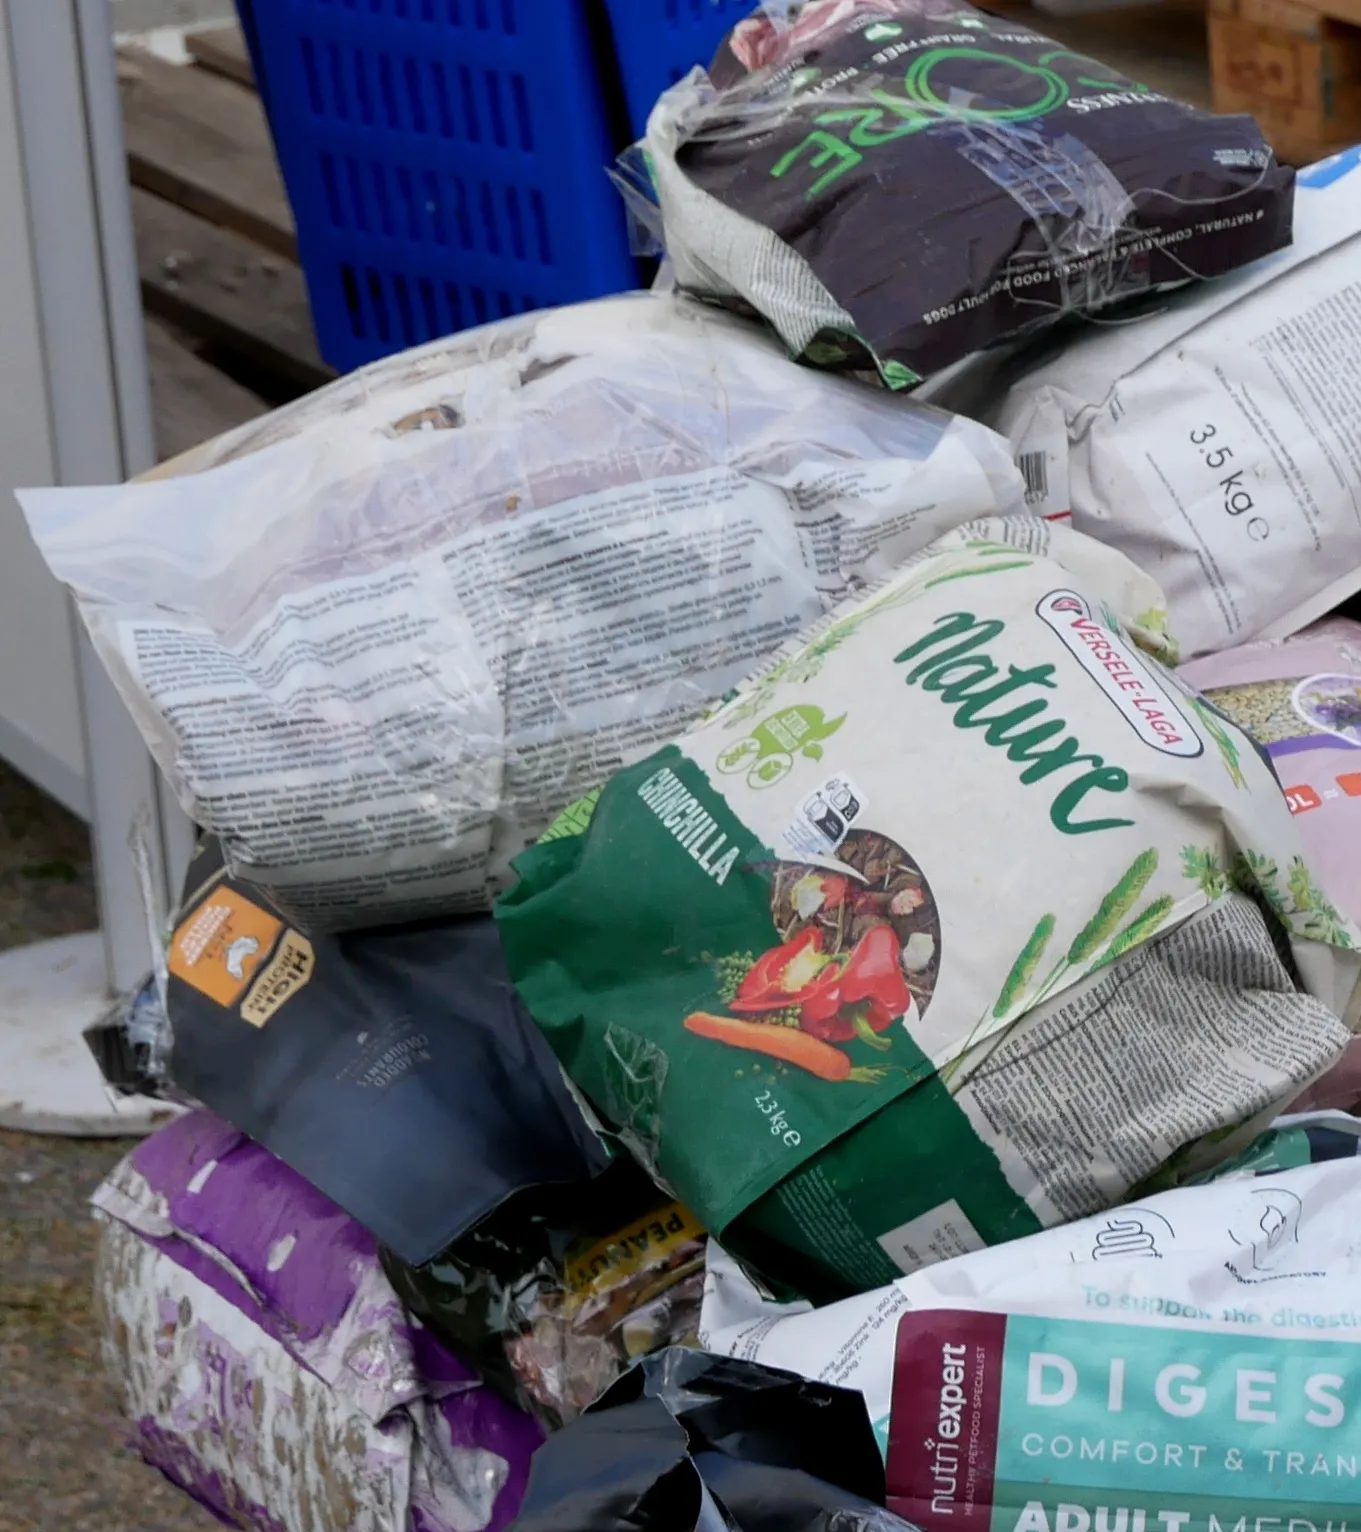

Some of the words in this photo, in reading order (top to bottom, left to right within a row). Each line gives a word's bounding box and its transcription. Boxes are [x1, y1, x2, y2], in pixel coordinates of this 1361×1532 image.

[1013, 267, 1050, 287] FOOD
[922, 303, 957, 325] DOGS
[1189, 421, 1232, 470] 3.5
[1218, 469, 1254, 519] kg
[893, 611, 1136, 835] Nature
[637, 767, 741, 886] CHINCHILLA
[754, 1090, 775, 1116] 2,3
[768, 1110, 789, 1138] kg
[1082, 1285, 1111, 1309] To
[973, 1345, 986, 1410] SPECIALIST
[925, 1342, 967, 1515] nutriexpert
[968, 1409, 982, 1464] PETFOOD
[1021, 1432, 1207, 1469] COMFORT
[1224, 1447, 1244, 1472] &
[963, 1461, 977, 1517] HEALTHY
